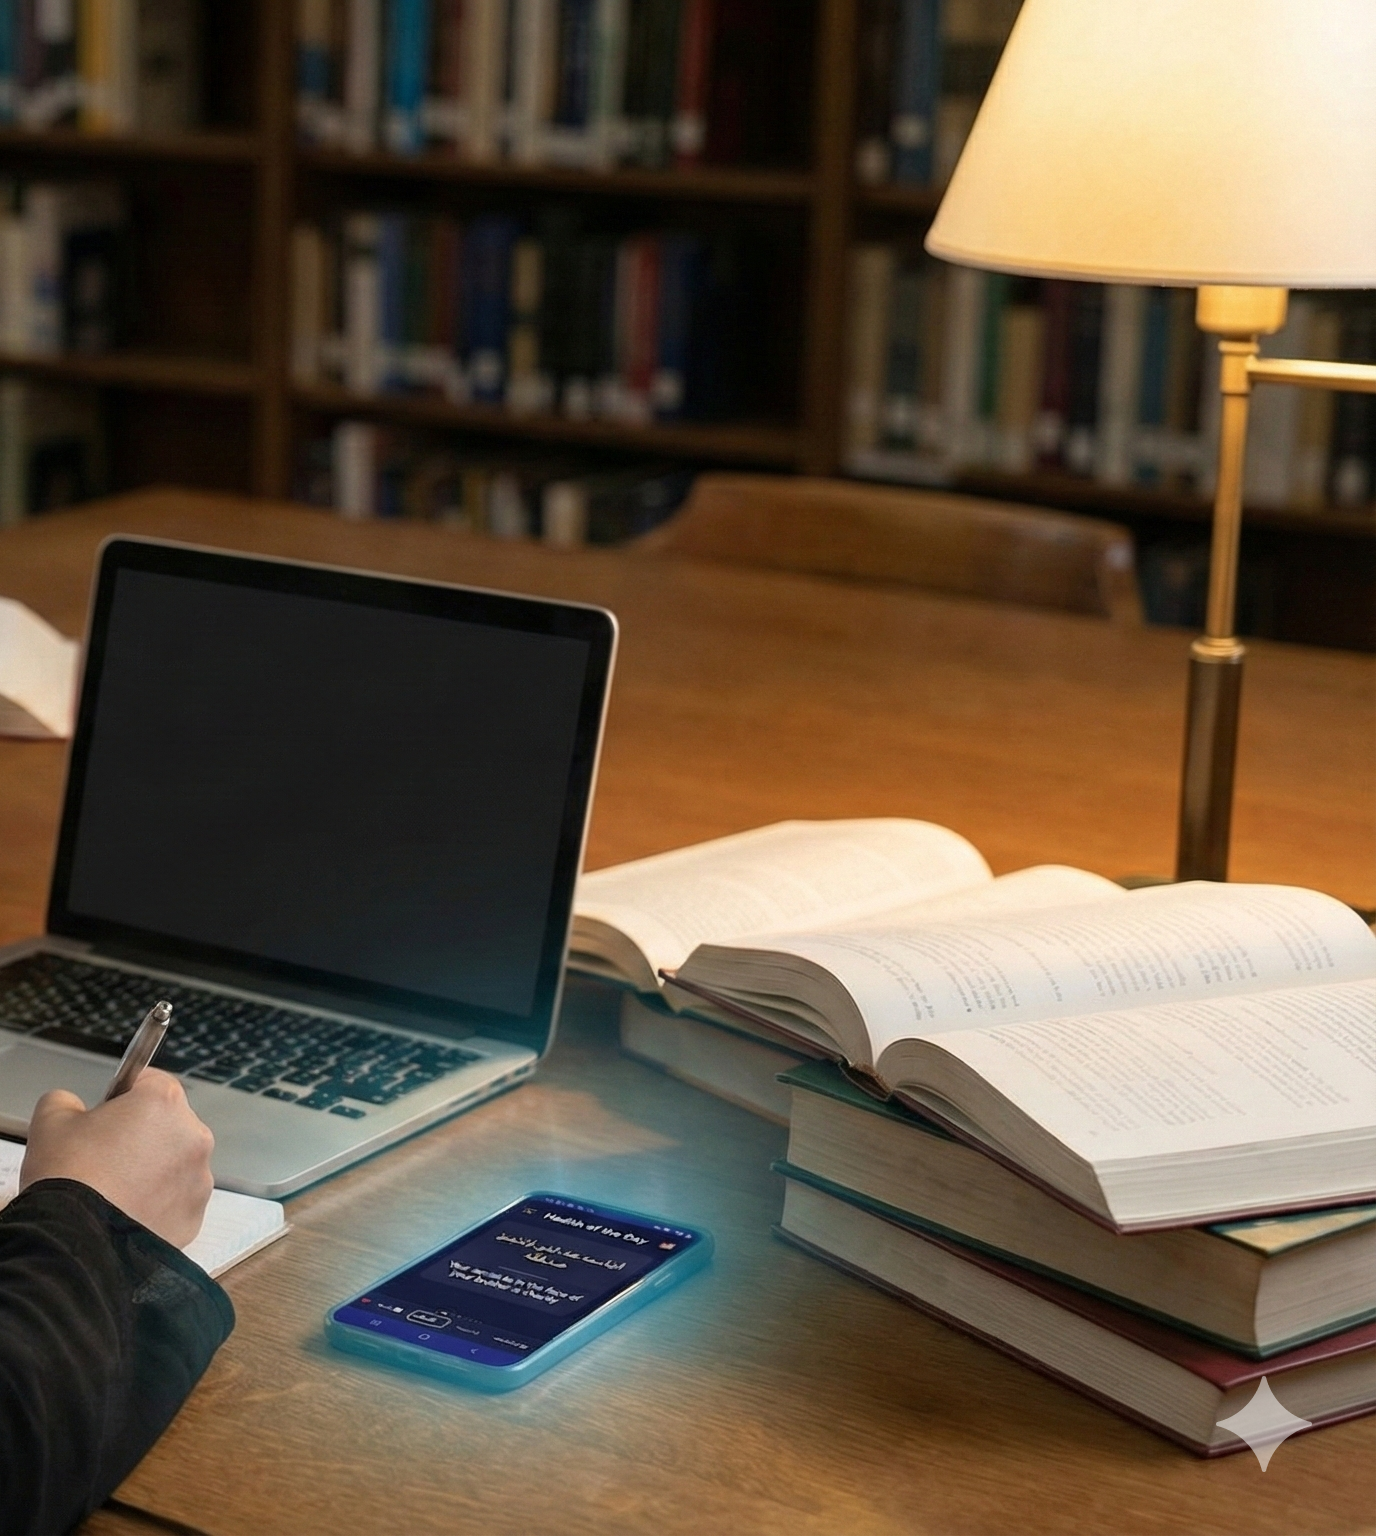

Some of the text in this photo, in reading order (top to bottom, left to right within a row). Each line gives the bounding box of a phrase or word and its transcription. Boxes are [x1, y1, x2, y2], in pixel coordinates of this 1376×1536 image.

[544, 1212, 584, 1228] Hadith
[586, 1224, 603, 1232] of
[601, 1227, 622, 1238] the
